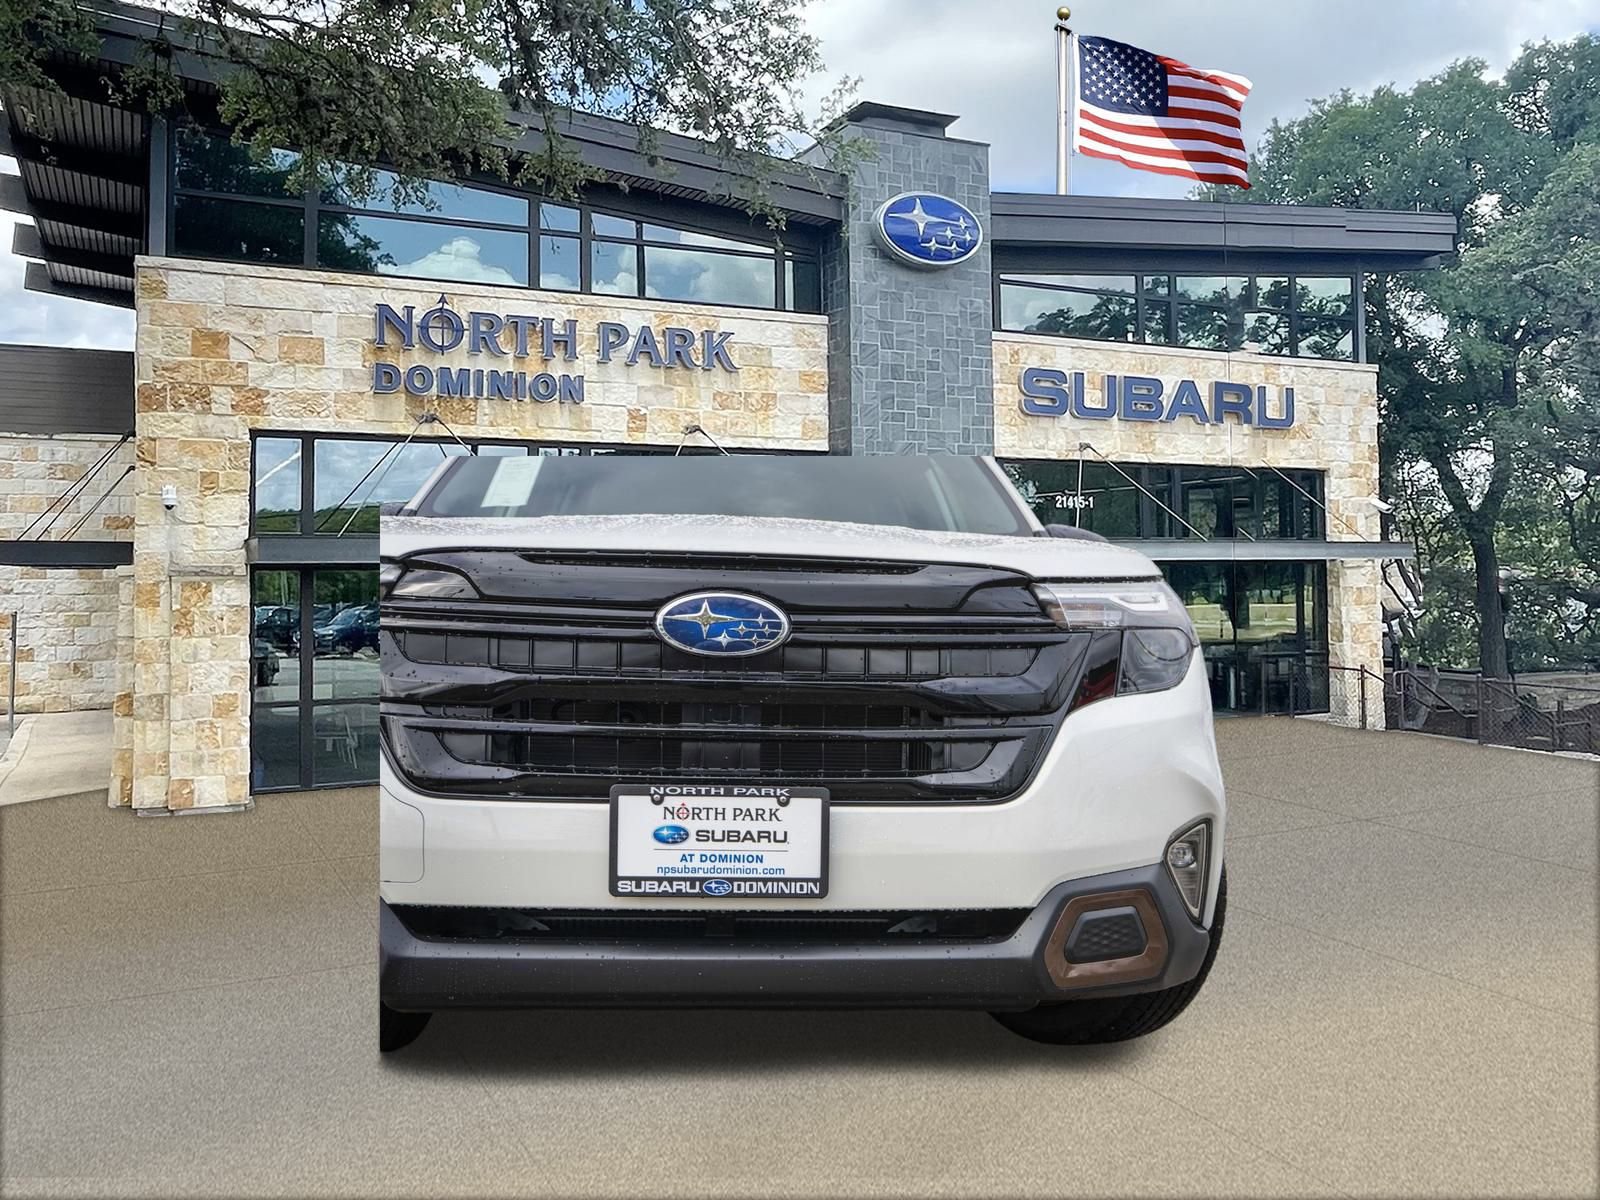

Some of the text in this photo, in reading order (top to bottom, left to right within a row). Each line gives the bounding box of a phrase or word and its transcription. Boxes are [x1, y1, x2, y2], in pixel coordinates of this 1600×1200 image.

[374, 302, 742, 373] NORTH PARK
[373, 362, 584, 404] DOMINION
[1018, 366, 1295, 430] SUBARU
[650, 786, 791, 796] NORTH PARK
[663, 805, 782, 821] NORTH PARK
[695, 829, 788, 843] SUBARU
[679, 853, 764, 863] AT DOMINION
[656, 864, 785, 876] npsubarudominion.com
[617, 880, 820, 894] SUBARU DOMINION
